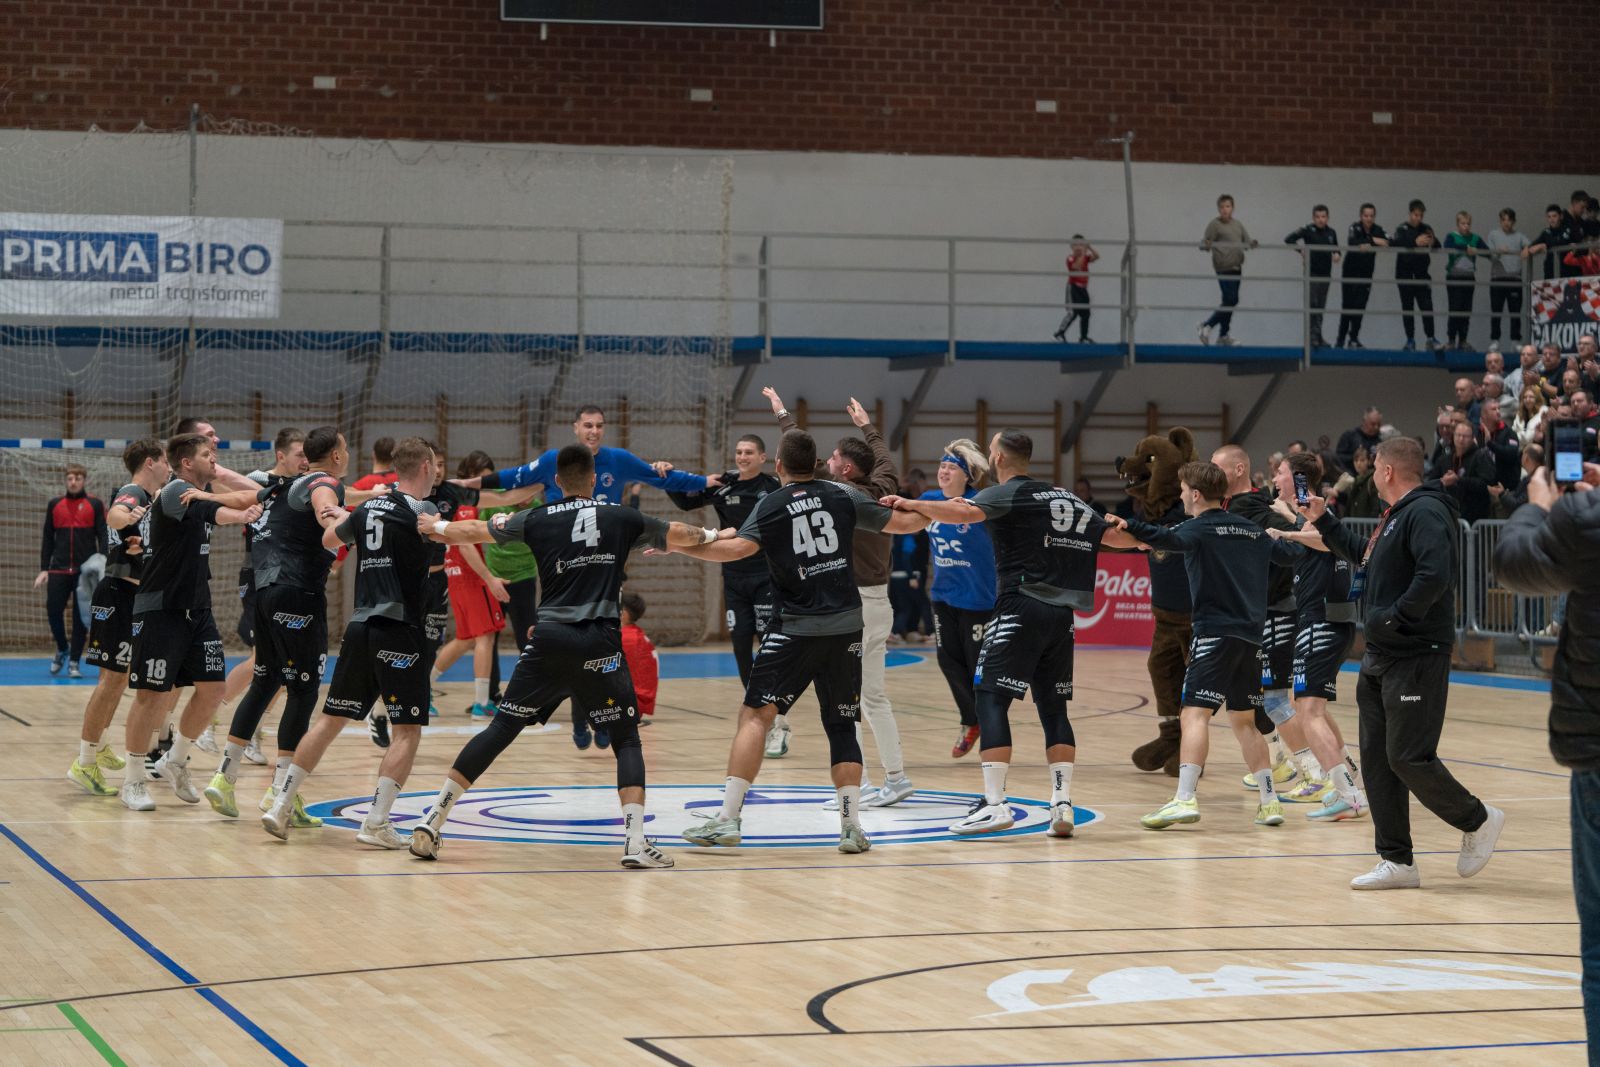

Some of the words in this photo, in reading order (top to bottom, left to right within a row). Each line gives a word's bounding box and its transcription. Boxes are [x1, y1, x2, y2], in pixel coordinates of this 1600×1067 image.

[3, 239, 152, 273] PRIMA
[164, 242, 271, 276] BIRO
[110, 285, 159, 300] metal
[166, 285, 268, 302] transformer
[571, 507, 600, 548] 4
[1050, 499, 1093, 534] 97
[366, 509, 386, 551] 5
[792, 510, 839, 558] 43
[145, 658, 167, 680] 18
[205, 655, 222, 664] biro
[589, 705, 622, 718] GALERIJA
[594, 713, 621, 724] SJEVER
[842, 795, 851, 818] Kempa
